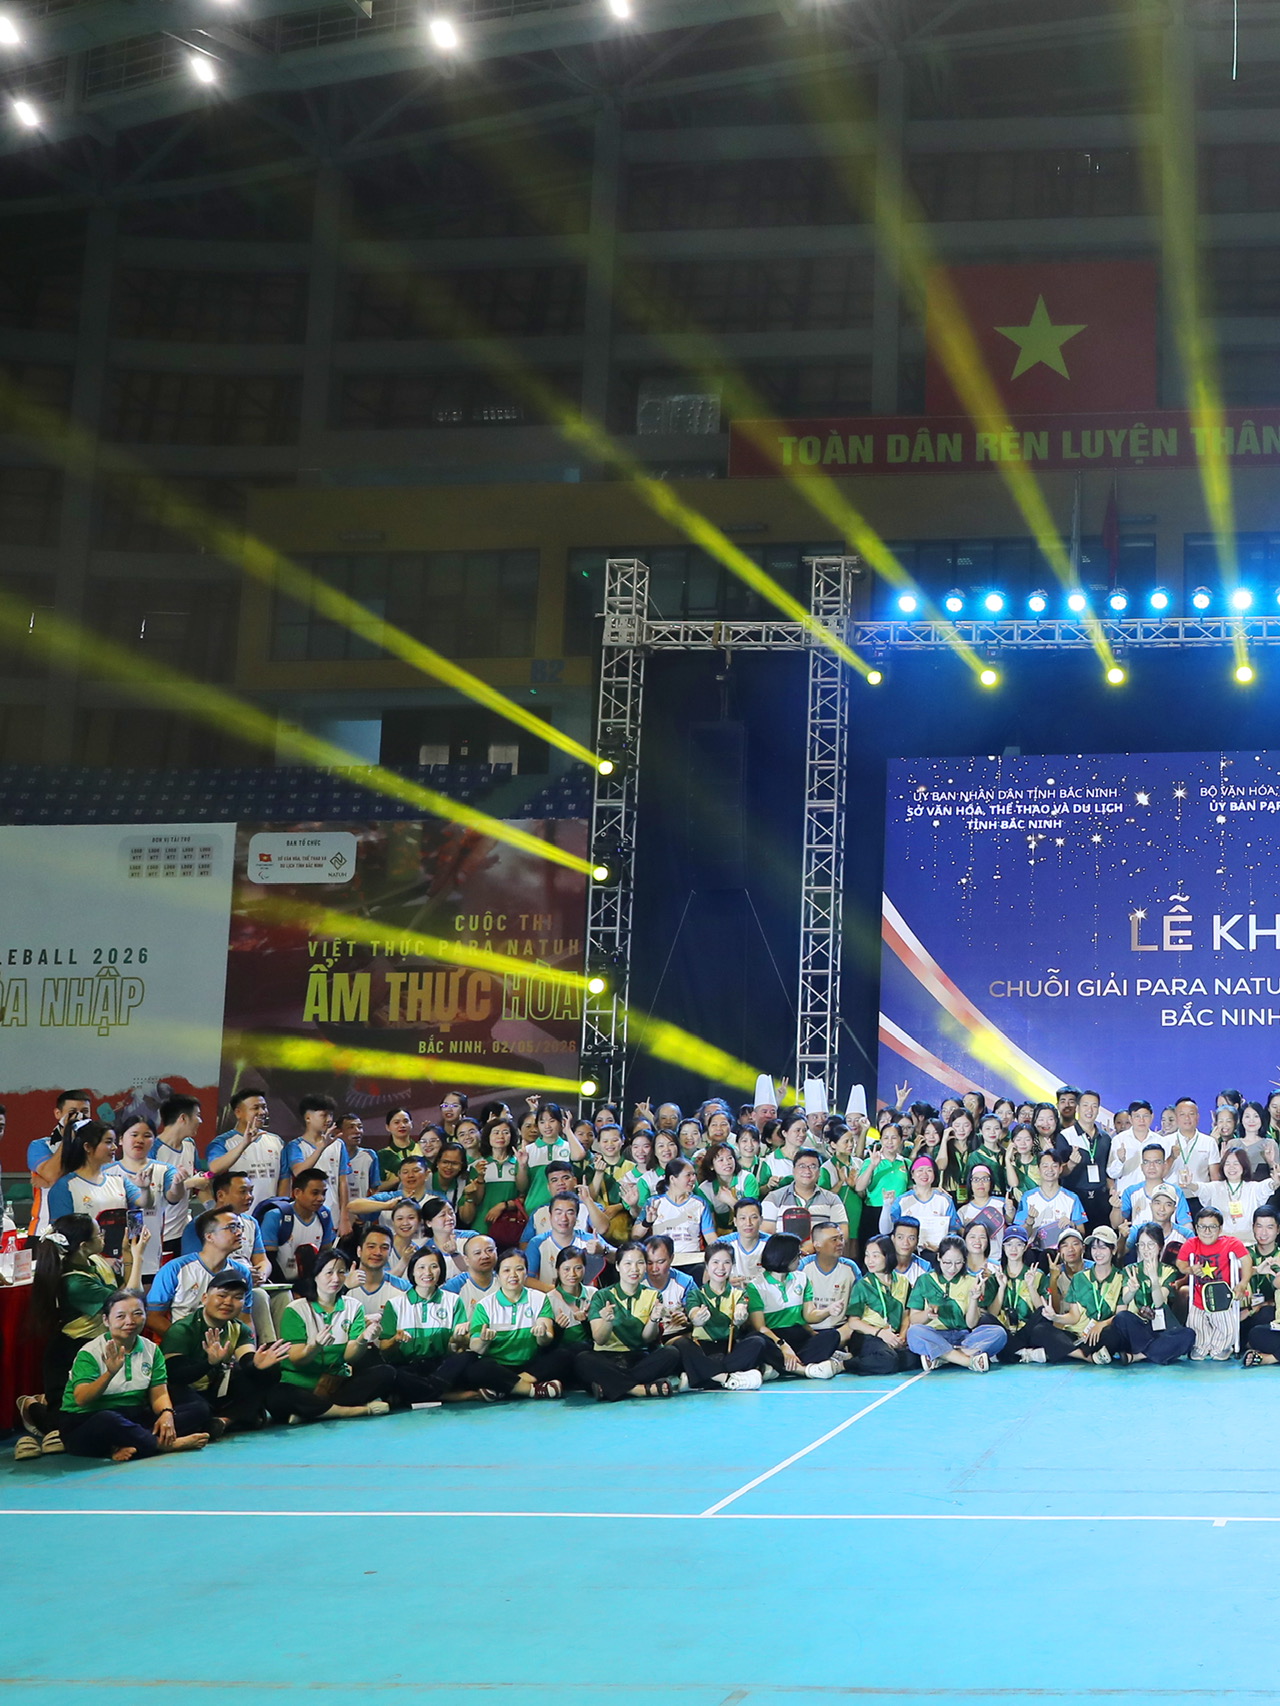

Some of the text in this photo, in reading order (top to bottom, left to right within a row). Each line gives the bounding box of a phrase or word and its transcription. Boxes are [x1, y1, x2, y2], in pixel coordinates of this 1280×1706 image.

[778, 429, 874, 466] TOÀN
[887, 427, 962, 464] DÂN
[976, 424, 1049, 462] RÈN
[1062, 422, 1177, 465] LUYỆN
[932, 791, 956, 801] BAN
[960, 788, 994, 800] NHÂN
[998, 788, 1023, 799] DÂN
[1059, 786, 1082, 798] BẮC
[1086, 788, 1117, 798] NINH
[1200, 785, 1218, 797] BỘ
[906, 804, 924, 816] SỞ
[927, 804, 952, 816] VĂN
[1015, 804, 1050, 814] THAO
[1053, 802, 1070, 814] VÀ
[1073, 803, 1091, 814] DU
[1094, 803, 1123, 815] LỊCH
[1000, 817, 1025, 829] BẮC
[1028, 819, 1062, 829] NINH
[454, 911, 552, 936] CUỘC THI
[1130, 894, 1193, 952] LỄ
[0, 947, 148, 965] EBALL 2026
[308, 938, 579, 961] VIỆT THỰC PARA NATUH
[989, 968, 1069, 998] CHUỖI
[1077, 971, 1128, 997] GIẢI
[1136, 978, 1208, 996] PARA
[39, 965, 146, 1037] NHẬP
[303, 958, 581, 1033] ẨM THỰC HÒA
[1160, 1001, 1214, 1027] BẮC
[418, 1035, 577, 1056] BẮC NINH, 02/05/2026
